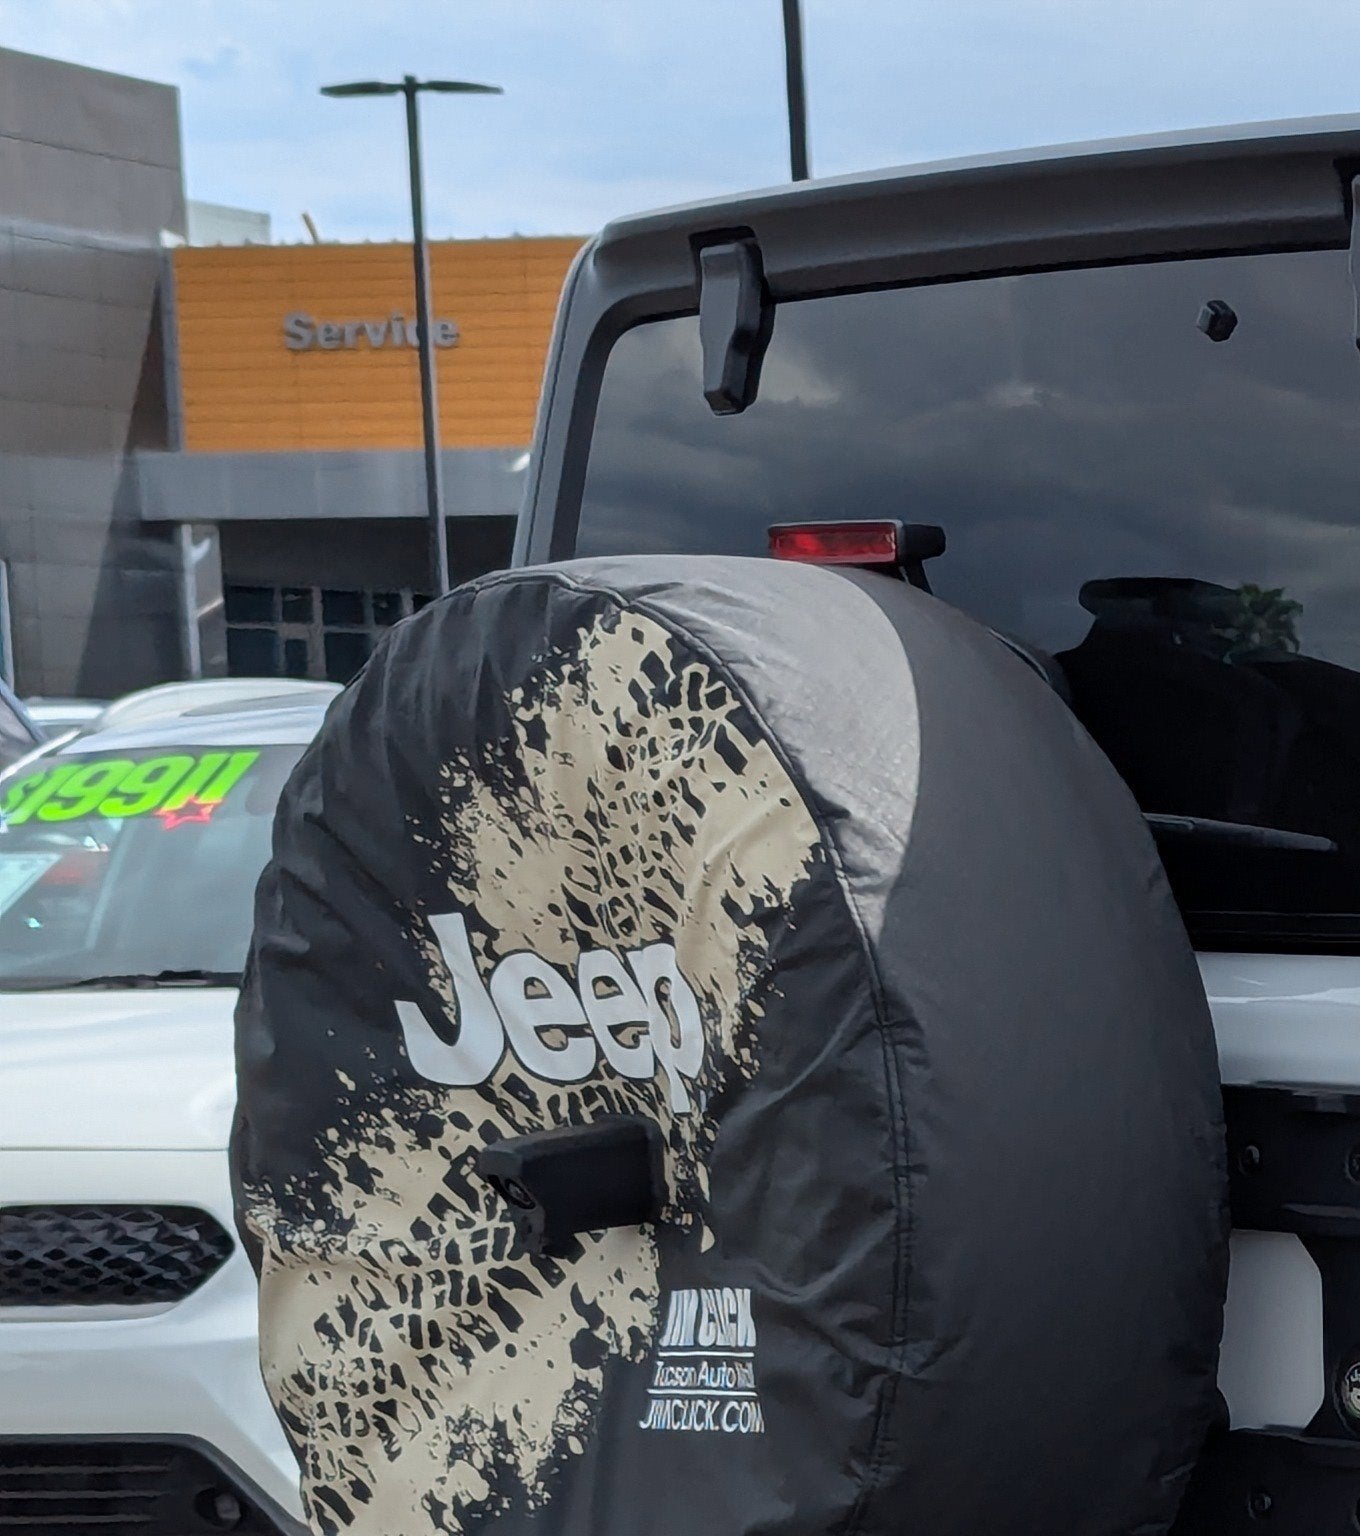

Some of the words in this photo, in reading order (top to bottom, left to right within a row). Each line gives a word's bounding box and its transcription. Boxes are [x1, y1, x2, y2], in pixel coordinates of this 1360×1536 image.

[394, 912, 706, 1114] Jeep
[654, 1361, 697, 1387] Tucson
[697, 1361, 737, 1388] Auto
